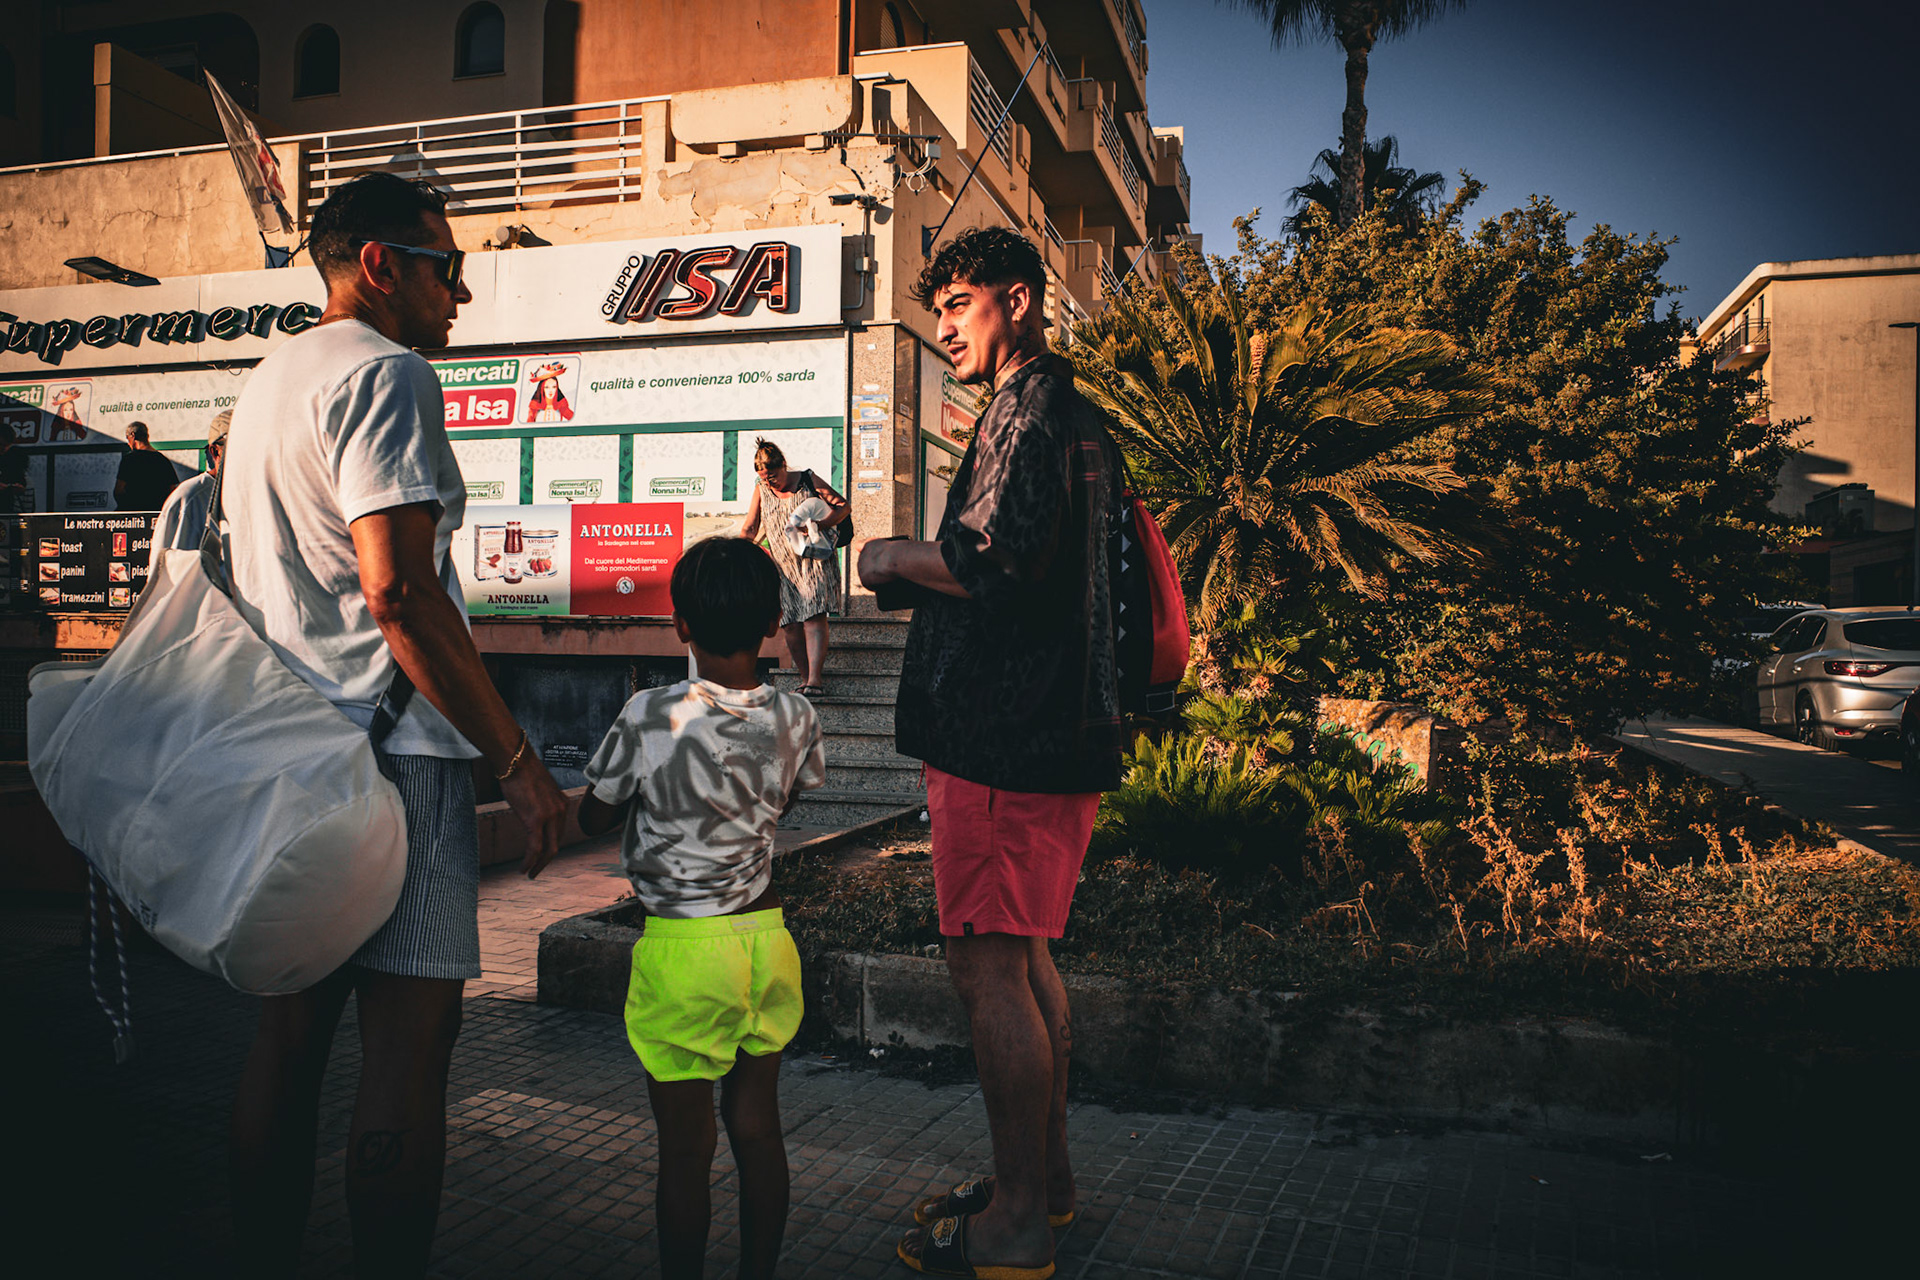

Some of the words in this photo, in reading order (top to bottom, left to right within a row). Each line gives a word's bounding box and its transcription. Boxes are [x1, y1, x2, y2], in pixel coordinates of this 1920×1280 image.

[601, 254, 640, 316] GRUPPO
[624, 241, 788, 320] ISA
[437, 361, 517, 383] mercati
[590, 377, 634, 393] qualità
[638, 379, 646, 388] e
[649, 374, 732, 388] convenienza
[737, 371, 772, 384] 100%
[776, 369, 816, 382] sarda
[99, 401, 134, 415] qualità
[136, 402, 143, 411] e
[145, 398, 211, 411] convenienza
[445, 401, 460, 421] a
[467, 395, 509, 420] Isa
[574, 488, 585, 496] Isa
[651, 487, 675, 495] Nonna
[676, 486, 687, 494] Isa
[64, 517, 75, 530] Le
[76, 519, 104, 530] nostre
[105, 516, 145, 531] specialità
[580, 523, 673, 538] ANTONELLA
[61, 541, 83, 553] toast
[626, 557, 668, 565] Mediterraneo
[61, 565, 86, 579] panini
[609, 565, 641, 573] pomodori
[61, 592, 105, 604] tramezzini
[487, 594, 550, 605] ANTONELLA
